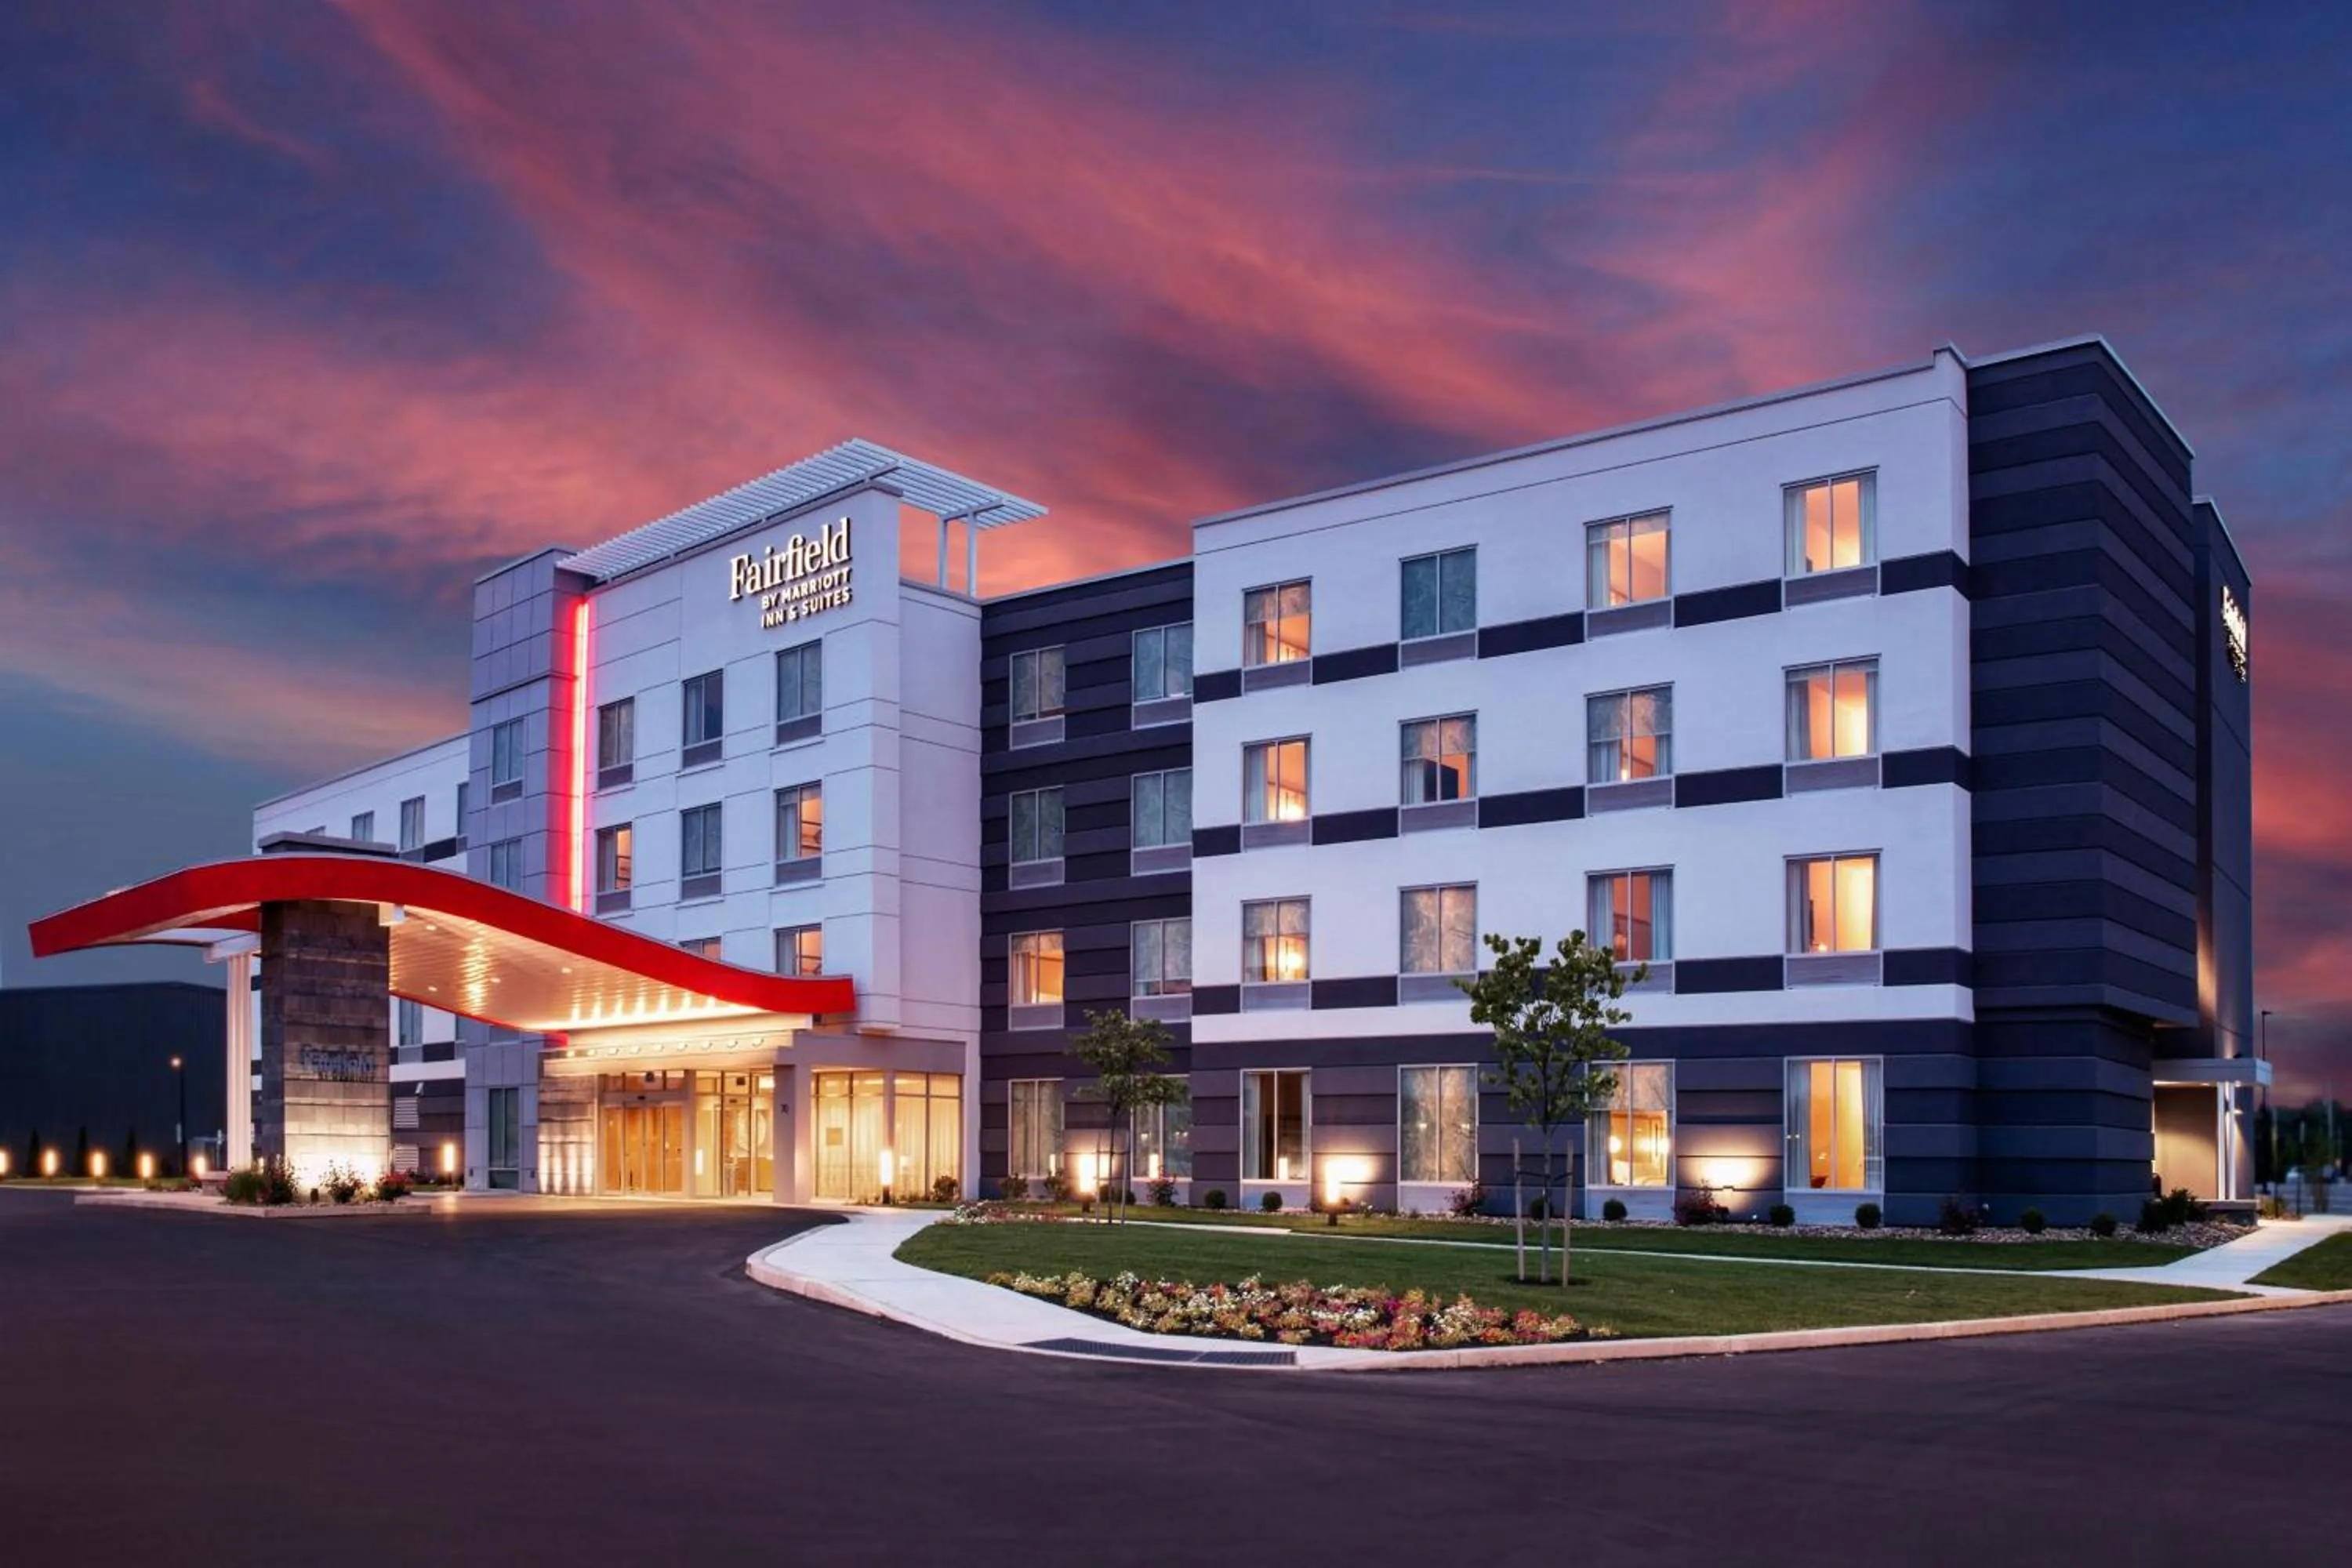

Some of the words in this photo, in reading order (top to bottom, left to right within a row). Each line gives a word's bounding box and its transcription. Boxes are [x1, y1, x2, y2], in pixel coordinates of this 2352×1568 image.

[729, 517, 851, 601] Fairfield
[761, 593, 779, 610] BY
[781, 567, 851, 604] MARRIOTT
[761, 608, 785, 628] INN
[788, 604, 798, 621] &
[801, 586, 851, 615] SUITES
